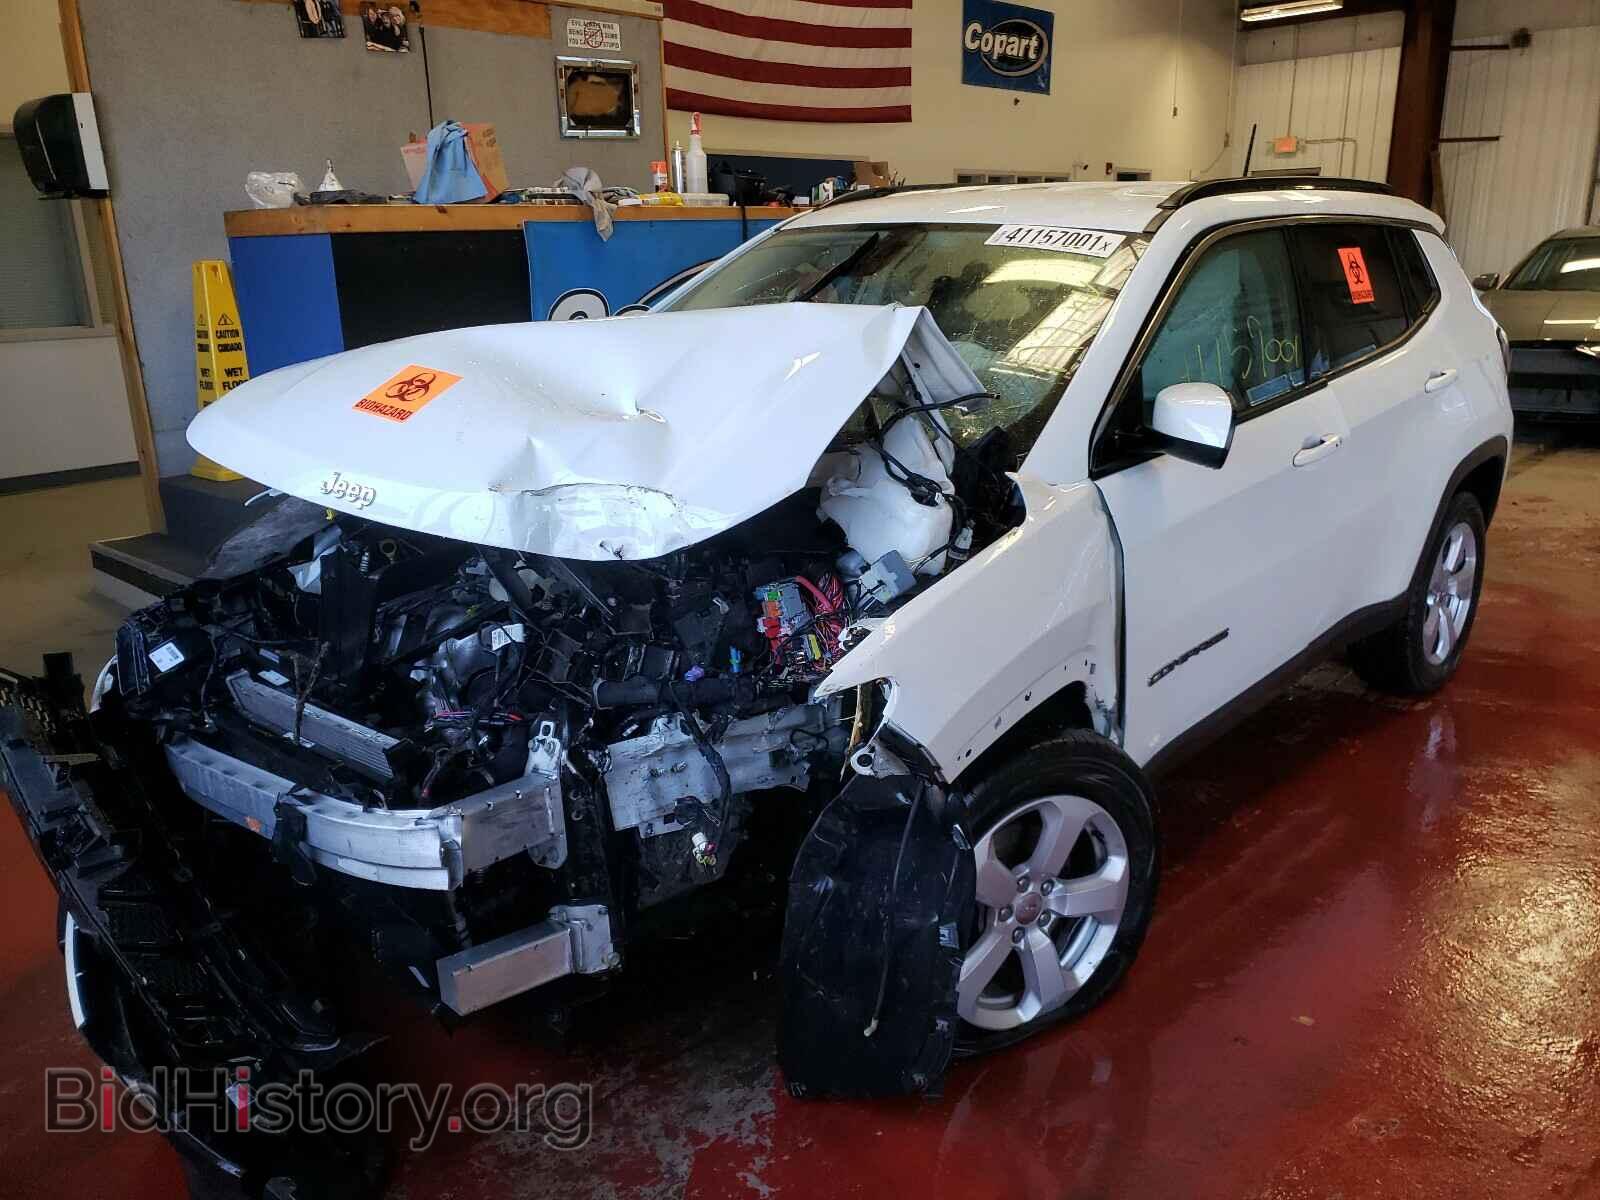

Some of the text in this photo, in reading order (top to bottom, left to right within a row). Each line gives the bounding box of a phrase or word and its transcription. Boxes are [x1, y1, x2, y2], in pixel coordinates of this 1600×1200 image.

[964, 22, 1039, 60] Copart
[1005, 227, 1104, 251] 41157001
[215, 329, 240, 339] CAUTION
[224, 367, 243, 377] WET
[222, 379, 249, 391] FLO
[354, 398, 414, 421] BIOHAZARD
[319, 471, 377, 510] Jeep
